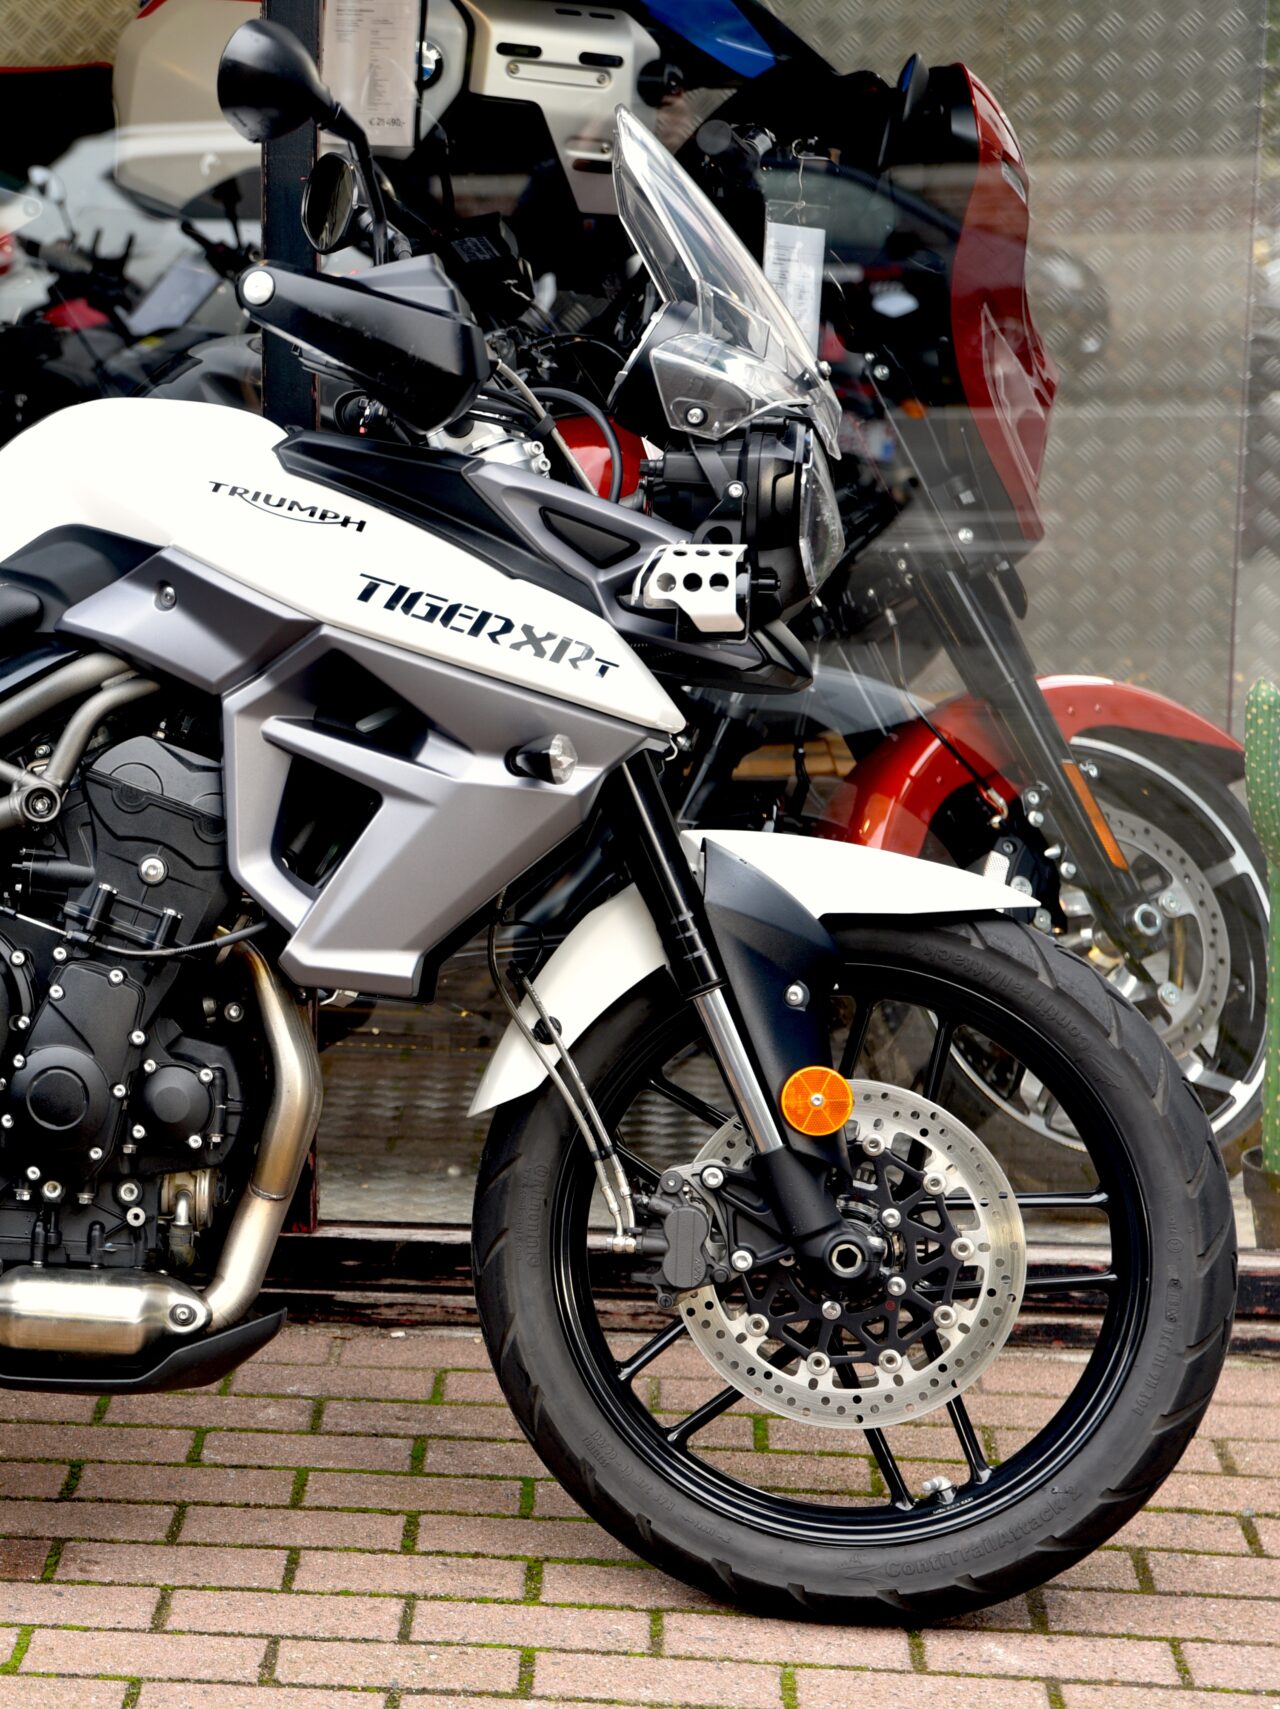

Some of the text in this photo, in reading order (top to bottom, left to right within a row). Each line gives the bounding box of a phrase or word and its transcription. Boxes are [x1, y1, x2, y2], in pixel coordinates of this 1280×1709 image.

[208, 480, 367, 533] TRIUMPH
[356, 572, 620, 679] TIGER XRT
[885, 1496, 1067, 1578] ContiTrailAttack
